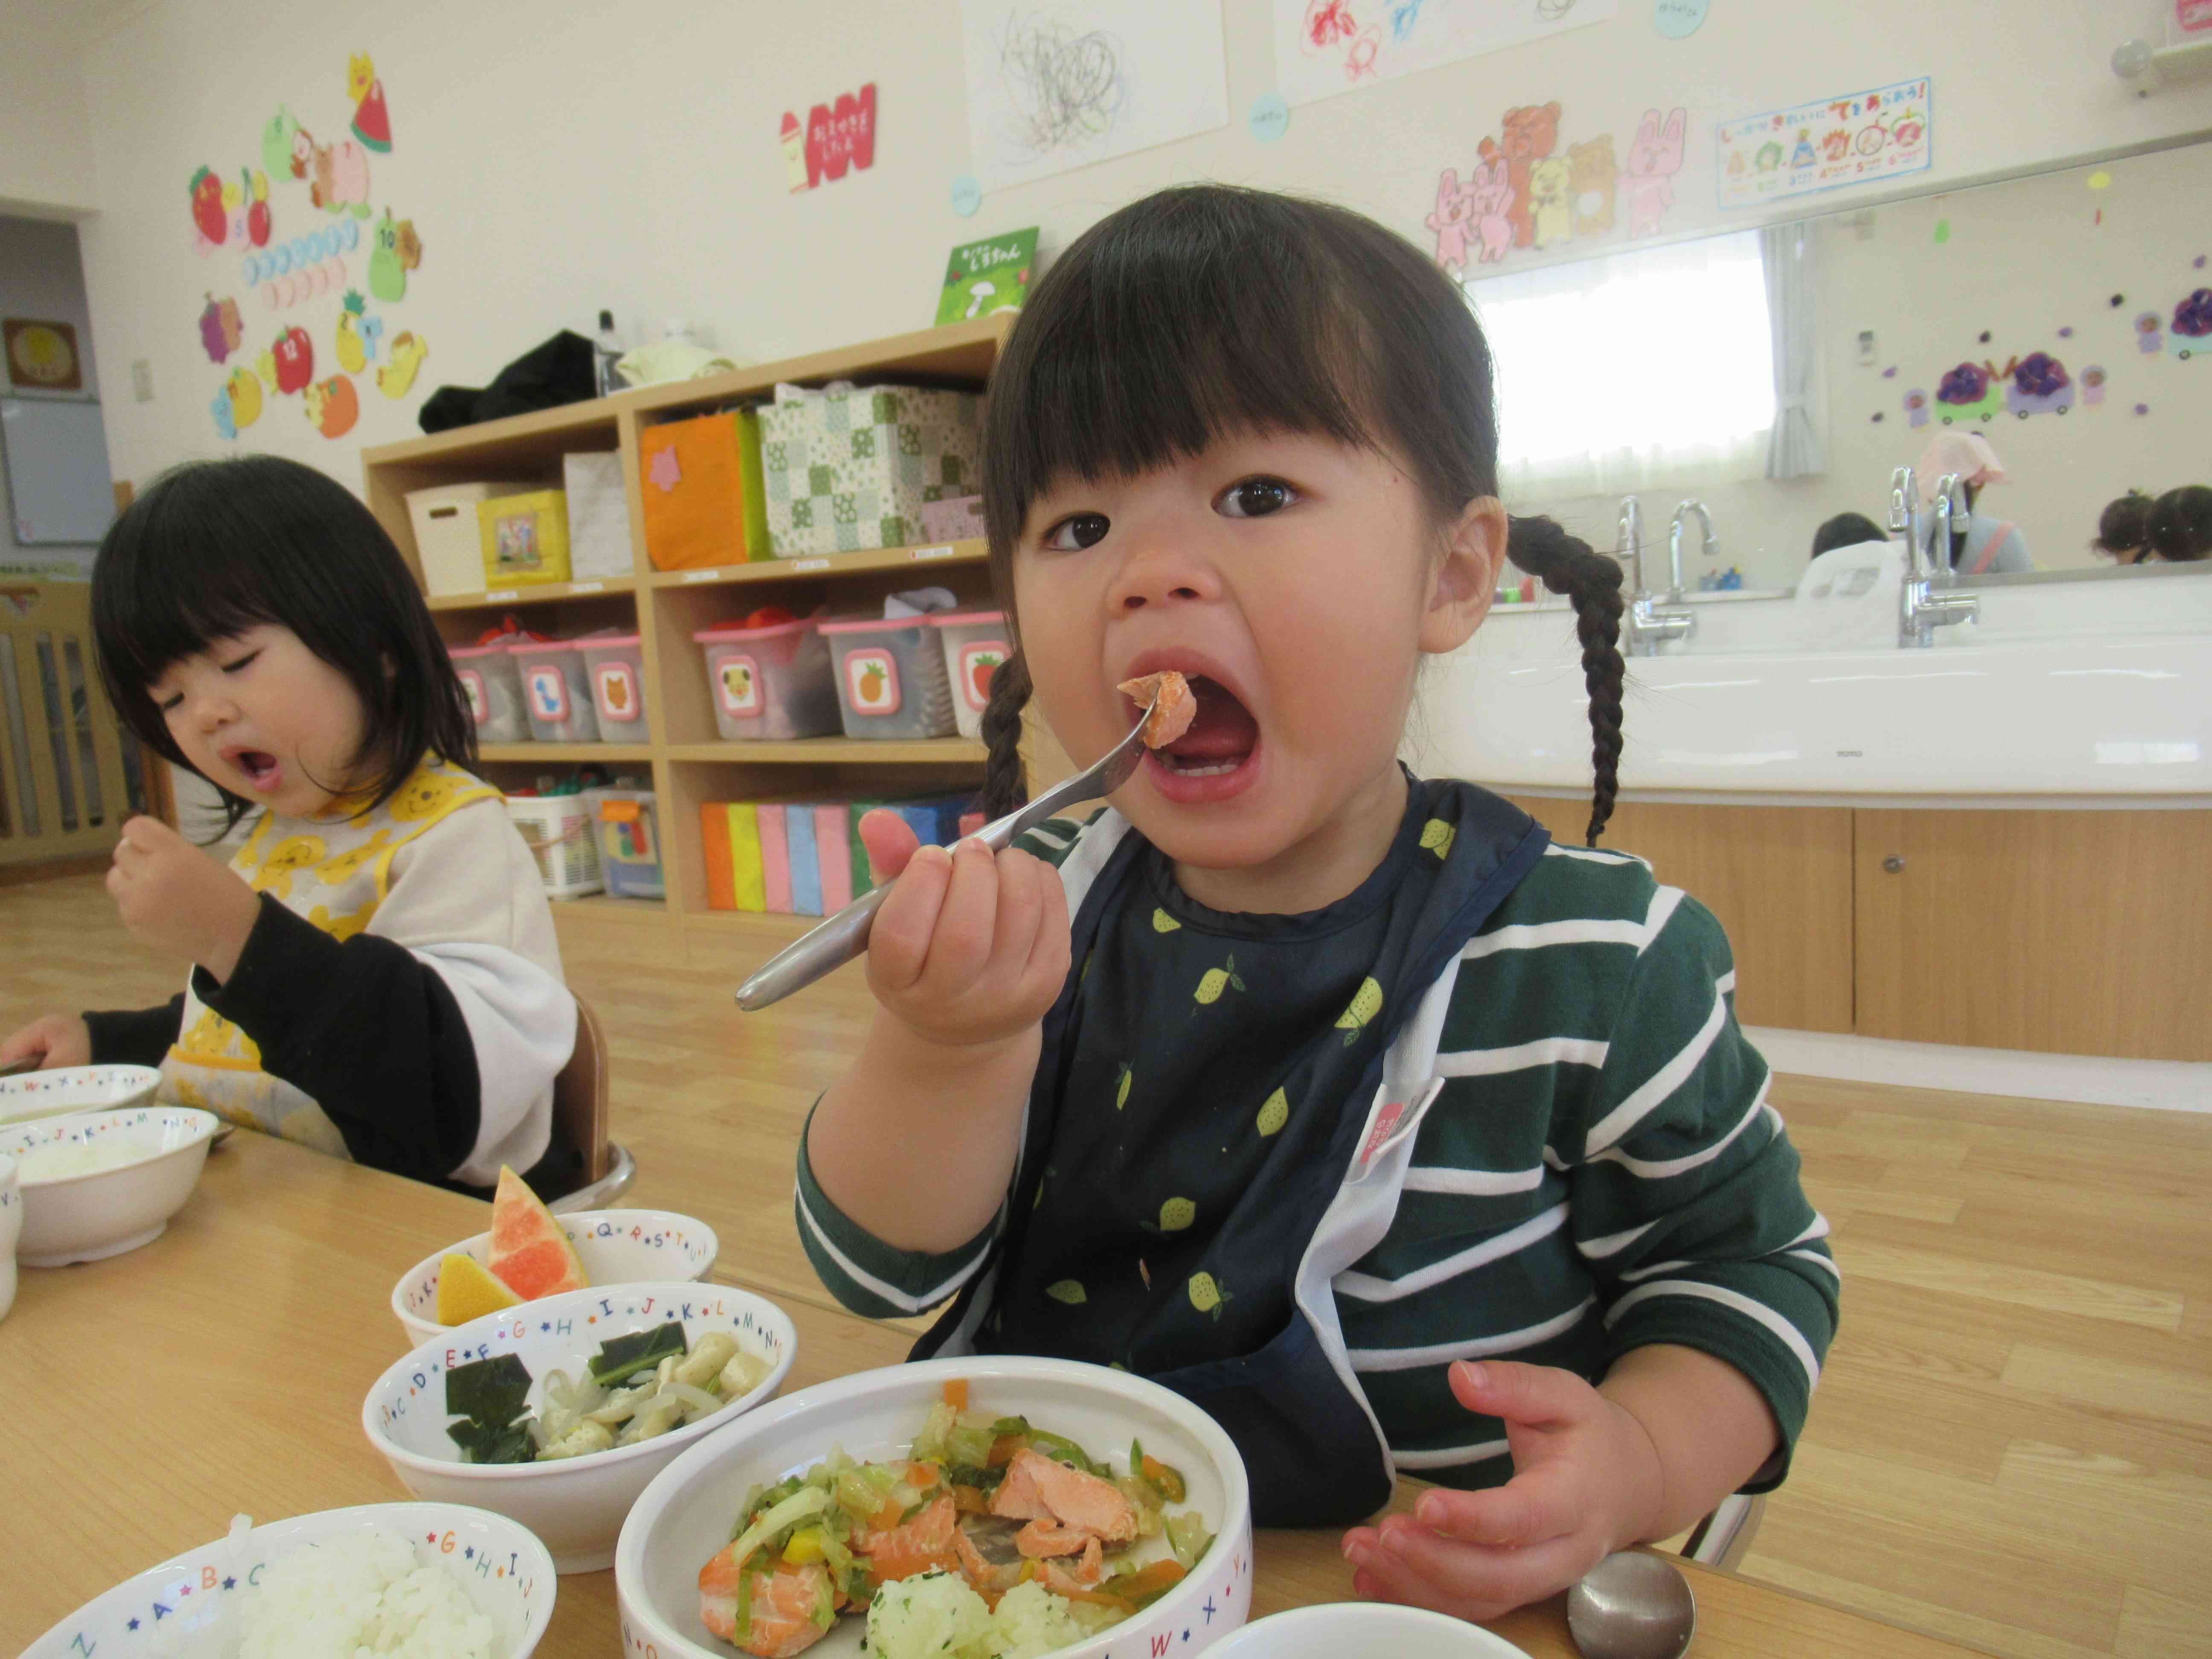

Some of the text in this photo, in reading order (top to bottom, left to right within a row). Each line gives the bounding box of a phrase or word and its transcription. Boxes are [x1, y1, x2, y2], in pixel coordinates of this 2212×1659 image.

[380, 228, 395, 249] 10
[25, 1080, 39, 1091] W
[60, 1077, 69, 1086] X
[54, 1128, 65, 1141] J
[84, 1126, 96, 1140] K
[137, 1112, 148, 1124] M
[597, 1222, 613, 1237] Q
[630, 1225, 640, 1240] R
[655, 1234, 663, 1247] S
[676, 1231, 683, 1246] T
[413, 1373, 426, 1389] D
[446, 1350, 456, 1368] E
[477, 1344, 489, 1360] F
[513, 1321, 525, 1339] G
[557, 1319, 572, 1335] H
[600, 1299, 613, 1316] I
[641, 1298, 655, 1314] J
[682, 1303, 693, 1320] K
[717, 1299, 724, 1316] L
[743, 1312, 753, 1329] M
[765, 1330, 772, 1348] N
[153, 1603, 173, 1621] A
[202, 1566, 217, 1590] B
[248, 1563, 265, 1586] C
[440, 1530, 456, 1553] G
[475, 1551, 492, 1578] H
[509, 1553, 518, 1575] I
[1151, 1630, 1173, 1659] W
[1234, 1553, 1239, 1578] Y
